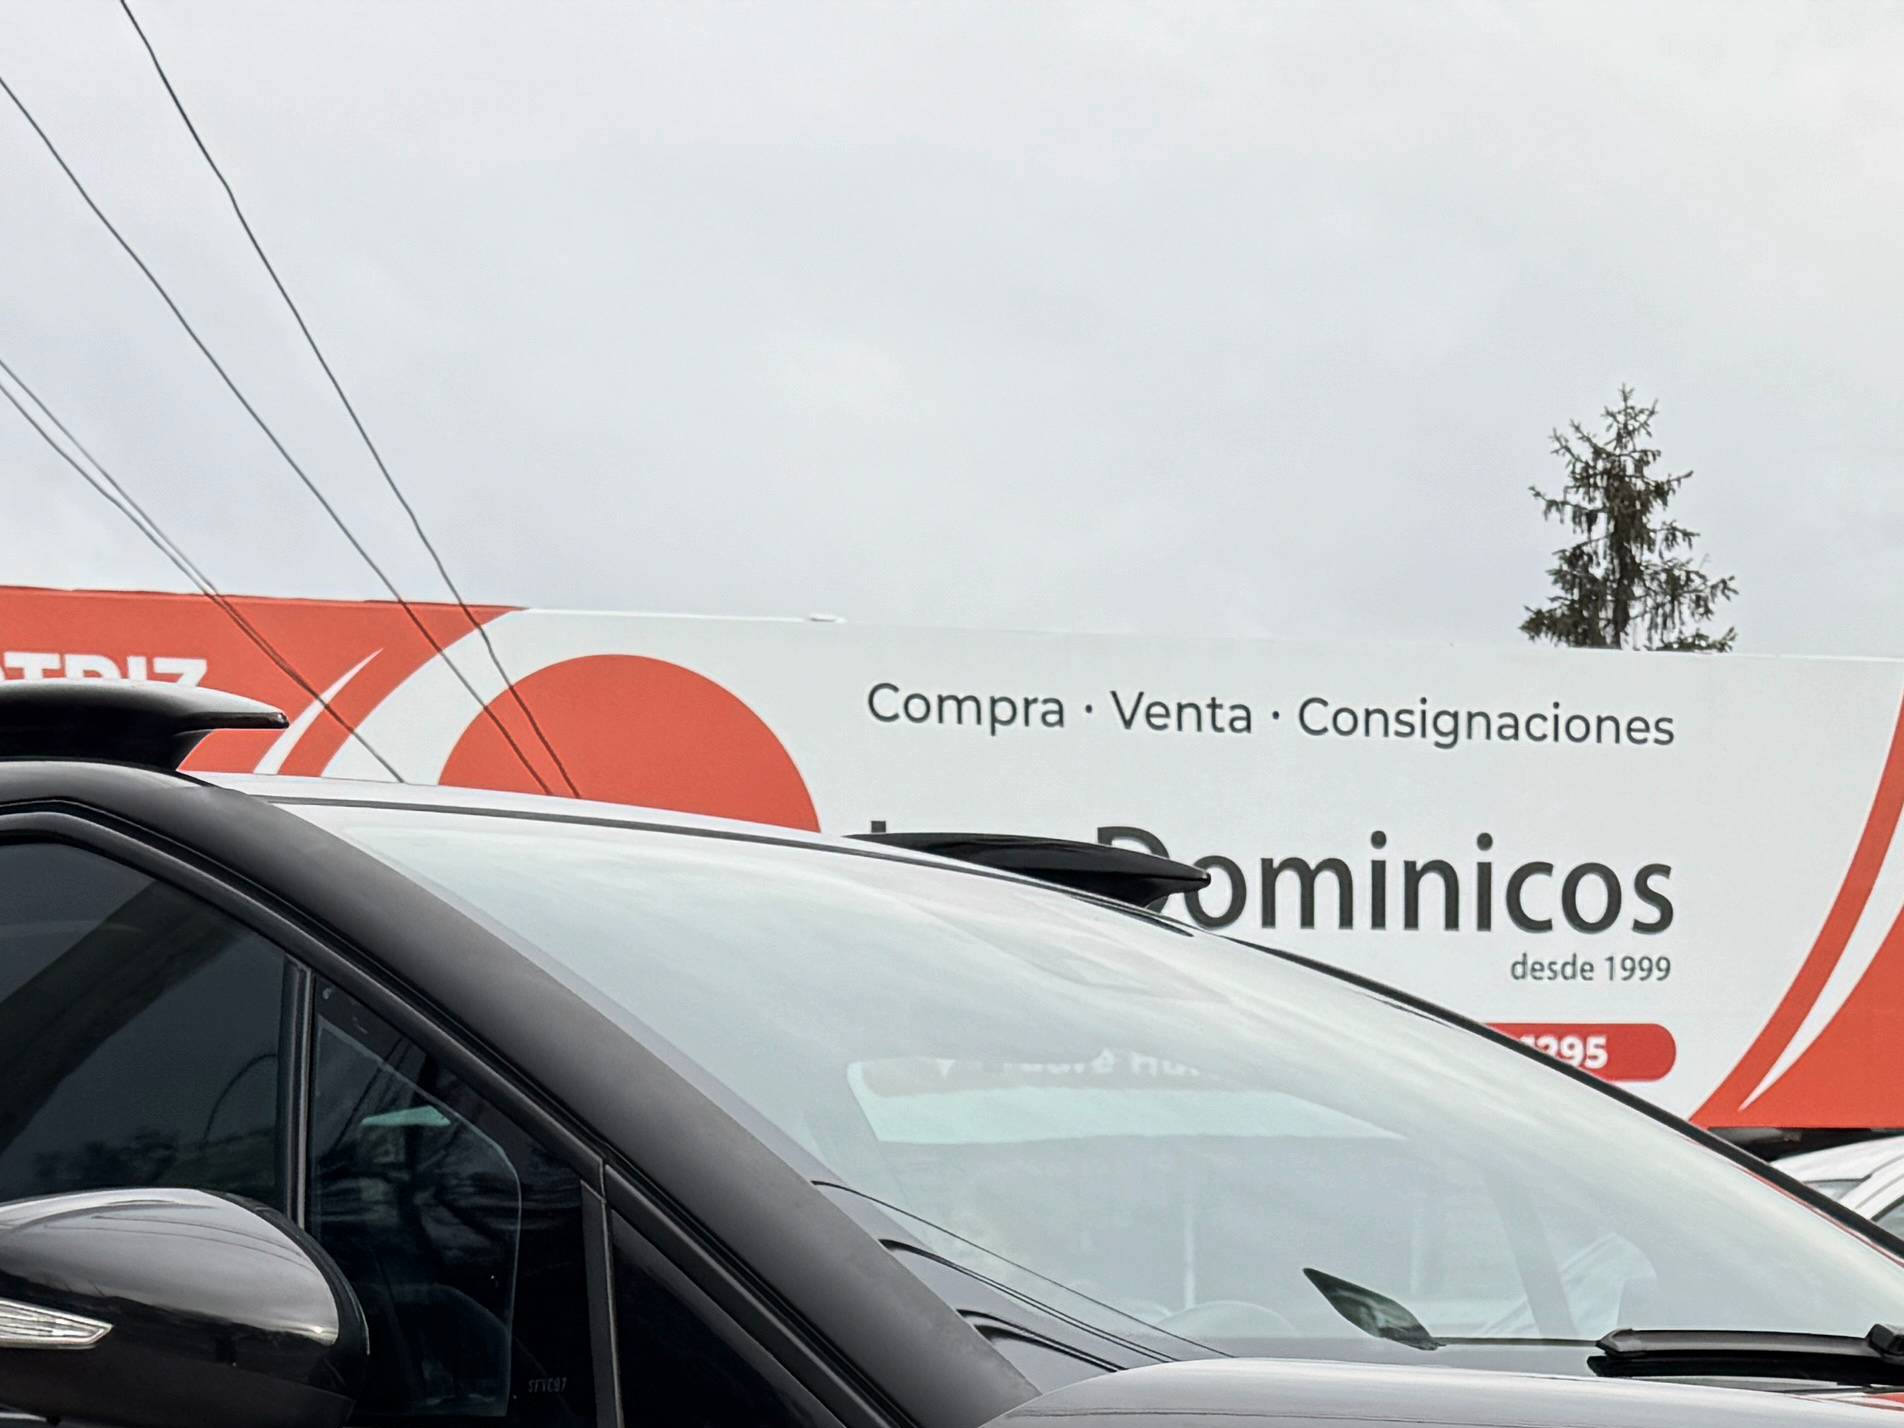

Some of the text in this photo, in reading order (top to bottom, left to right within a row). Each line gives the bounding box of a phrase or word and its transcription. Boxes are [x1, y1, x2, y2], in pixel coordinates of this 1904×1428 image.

[867, 683, 1675, 750] Compra Venta Consignaciones
[1511, 952, 1671, 981] desde 1999
